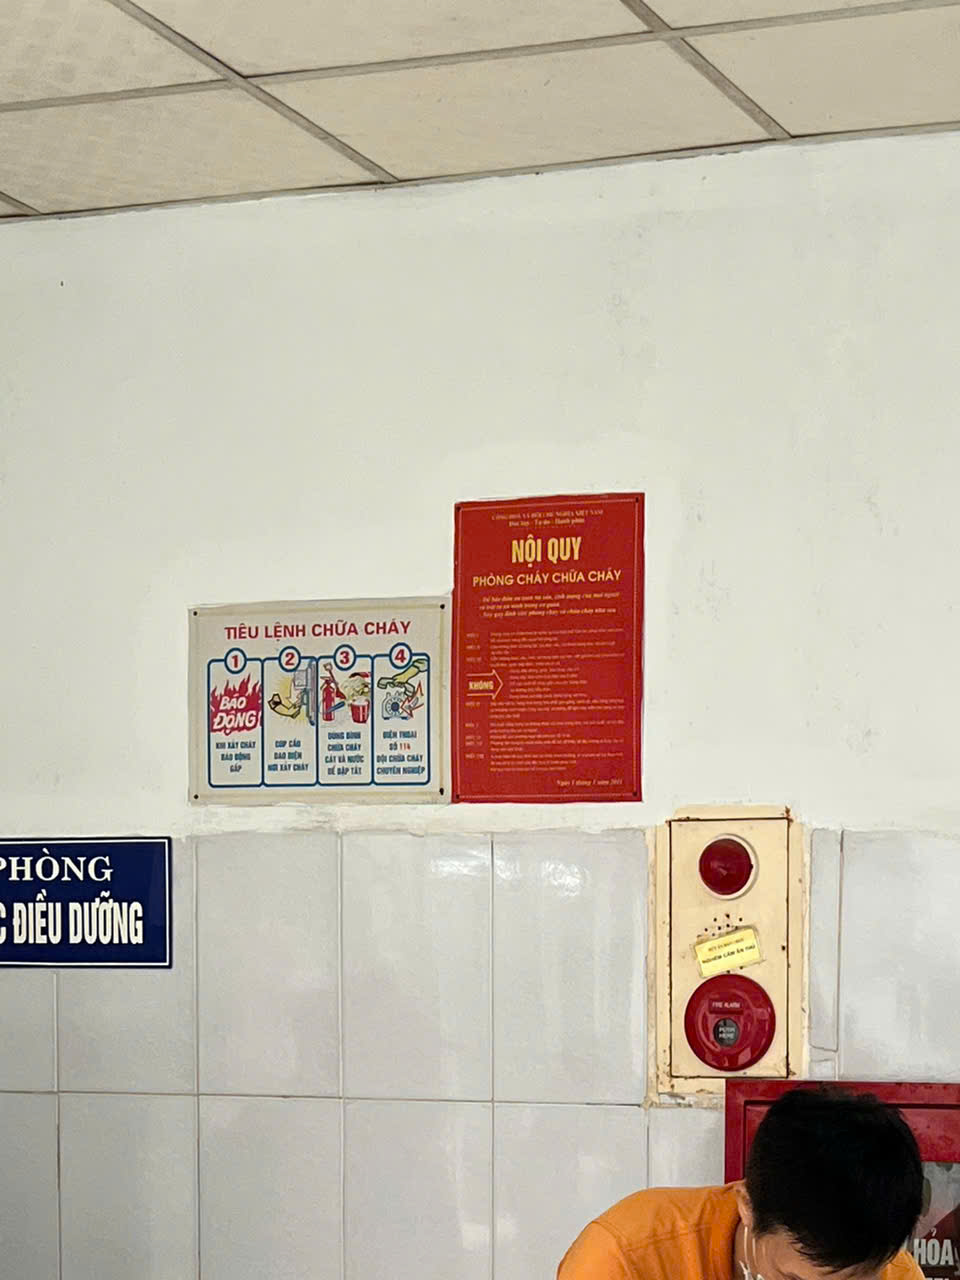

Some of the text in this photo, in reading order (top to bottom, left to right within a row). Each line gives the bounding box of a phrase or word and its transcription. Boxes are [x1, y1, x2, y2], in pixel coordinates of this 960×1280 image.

[512, 534, 582, 568] NỘI QUY
[516, 569, 549, 585] CHÁY
[552, 568, 585, 584] CHỮA
[588, 567, 621, 582] CHÁY
[224, 618, 411, 642] TIÊU LỆNH CHỮA CHÁY
[231, 655, 239, 668] 1
[285, 652, 295, 666] 2
[340, 651, 350, 664] 3
[394, 648, 406, 663] 4
[219, 692, 247, 710] BÁO
[213, 710, 257, 733] ĐỘNG
[13, 889, 62, 944] ĐIỀU
[69, 890, 144, 944] DƯỠNG
